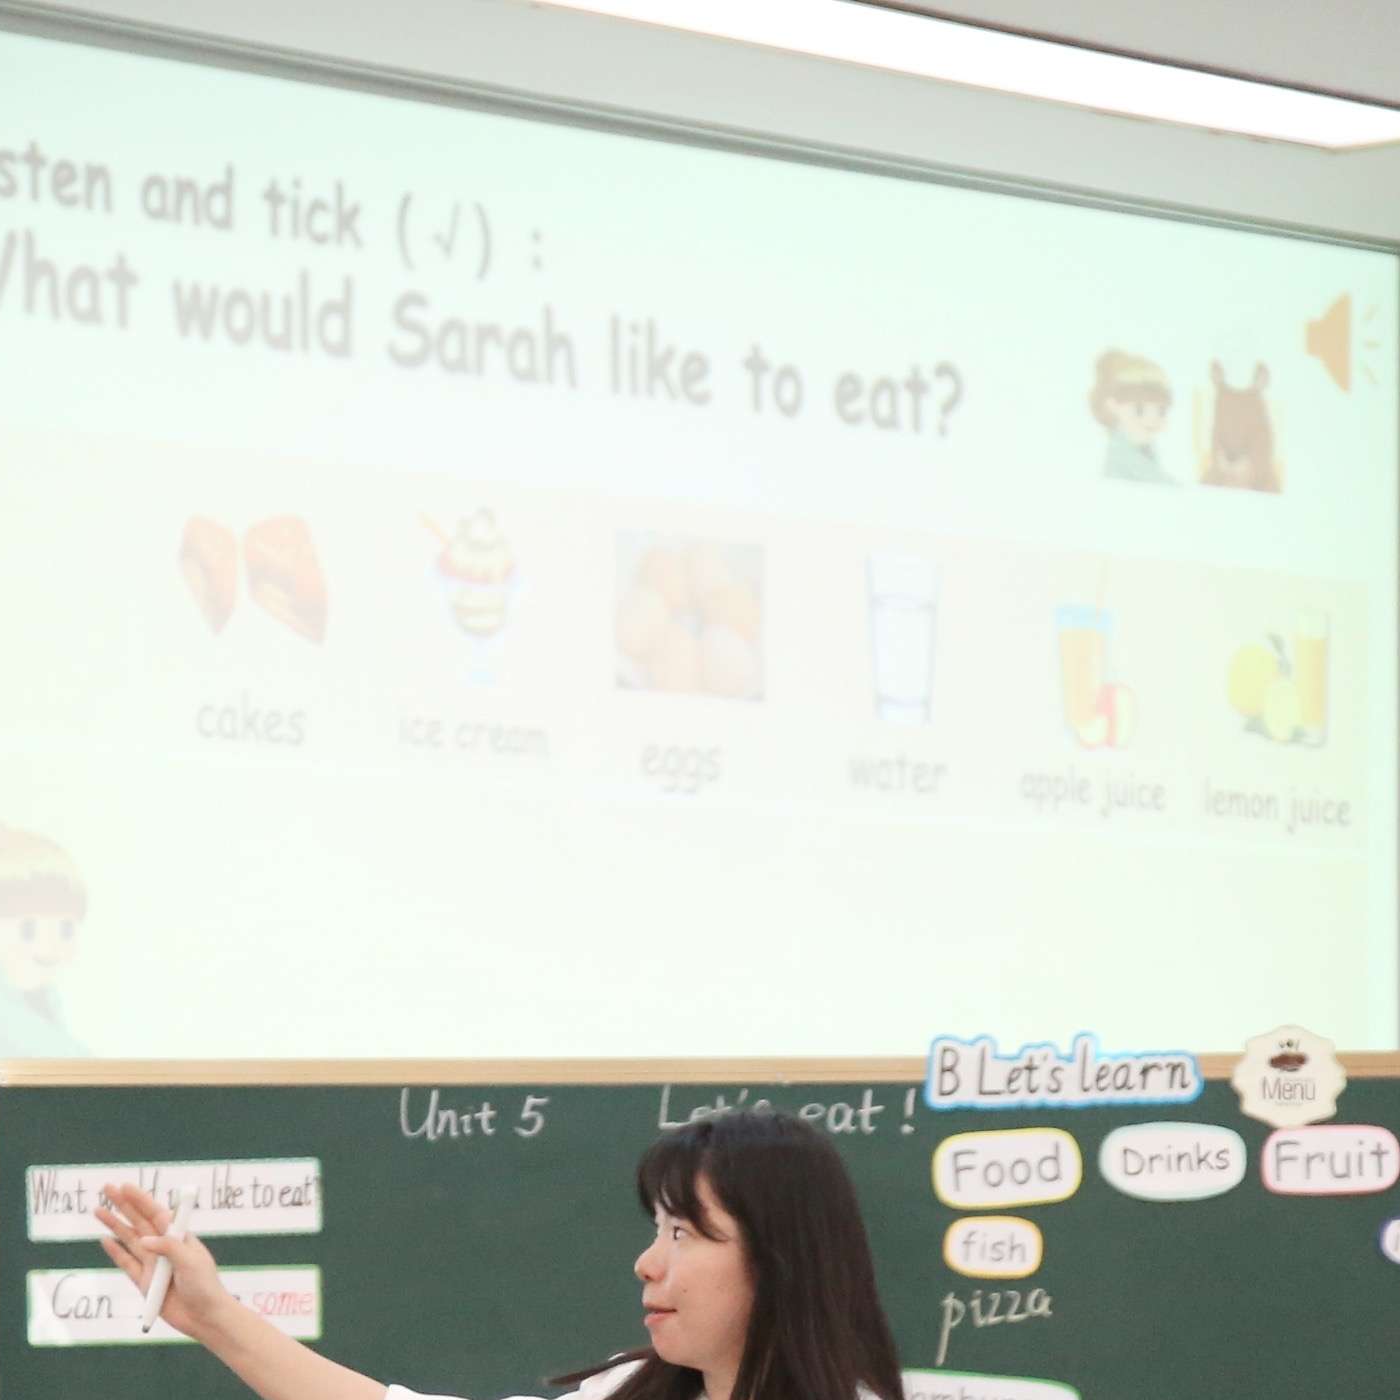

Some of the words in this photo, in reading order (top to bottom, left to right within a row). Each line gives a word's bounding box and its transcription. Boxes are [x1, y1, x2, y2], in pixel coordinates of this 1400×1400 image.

[140, 164, 236, 231] and
[262, 178, 364, 250] tick
[173, 269, 356, 359] would
[387, 290, 579, 391] Sarah
[608, 314, 713, 408] like
[743, 344, 805, 420] to
[833, 361, 966, 439] eat?
[197, 691, 306, 748] cakes
[399, 714, 443, 750] ice
[453, 722, 551, 758] cream
[640, 739, 722, 795] eggs
[848, 750, 949, 797] water
[1018, 770, 1092, 814] apple
[1099, 771, 1167, 819] juice
[1204, 777, 1281, 822] lemon
[1286, 788, 1352, 835] juice
[937, 1045, 961, 1098] B
[978, 1045, 1065, 1097] Let's
[1080, 1042, 1191, 1093] learn
[1261, 1076, 1316, 1101] Menu
[400, 1086, 496, 1140] Unit
[514, 1094, 550, 1138] 5
[951, 1142, 1063, 1192] Food
[1121, 1142, 1231, 1176] Drinks
[1274, 1139, 1391, 1182] Fruit
[31, 1169, 88, 1215] What
[210, 1164, 244, 1211] like
[252, 1180, 274, 1209] to
[961, 1230, 1027, 1263] fish
[52, 1273, 114, 1320] Can
[251, 1290, 314, 1317] some
[935, 1287, 1053, 1367] pizza
